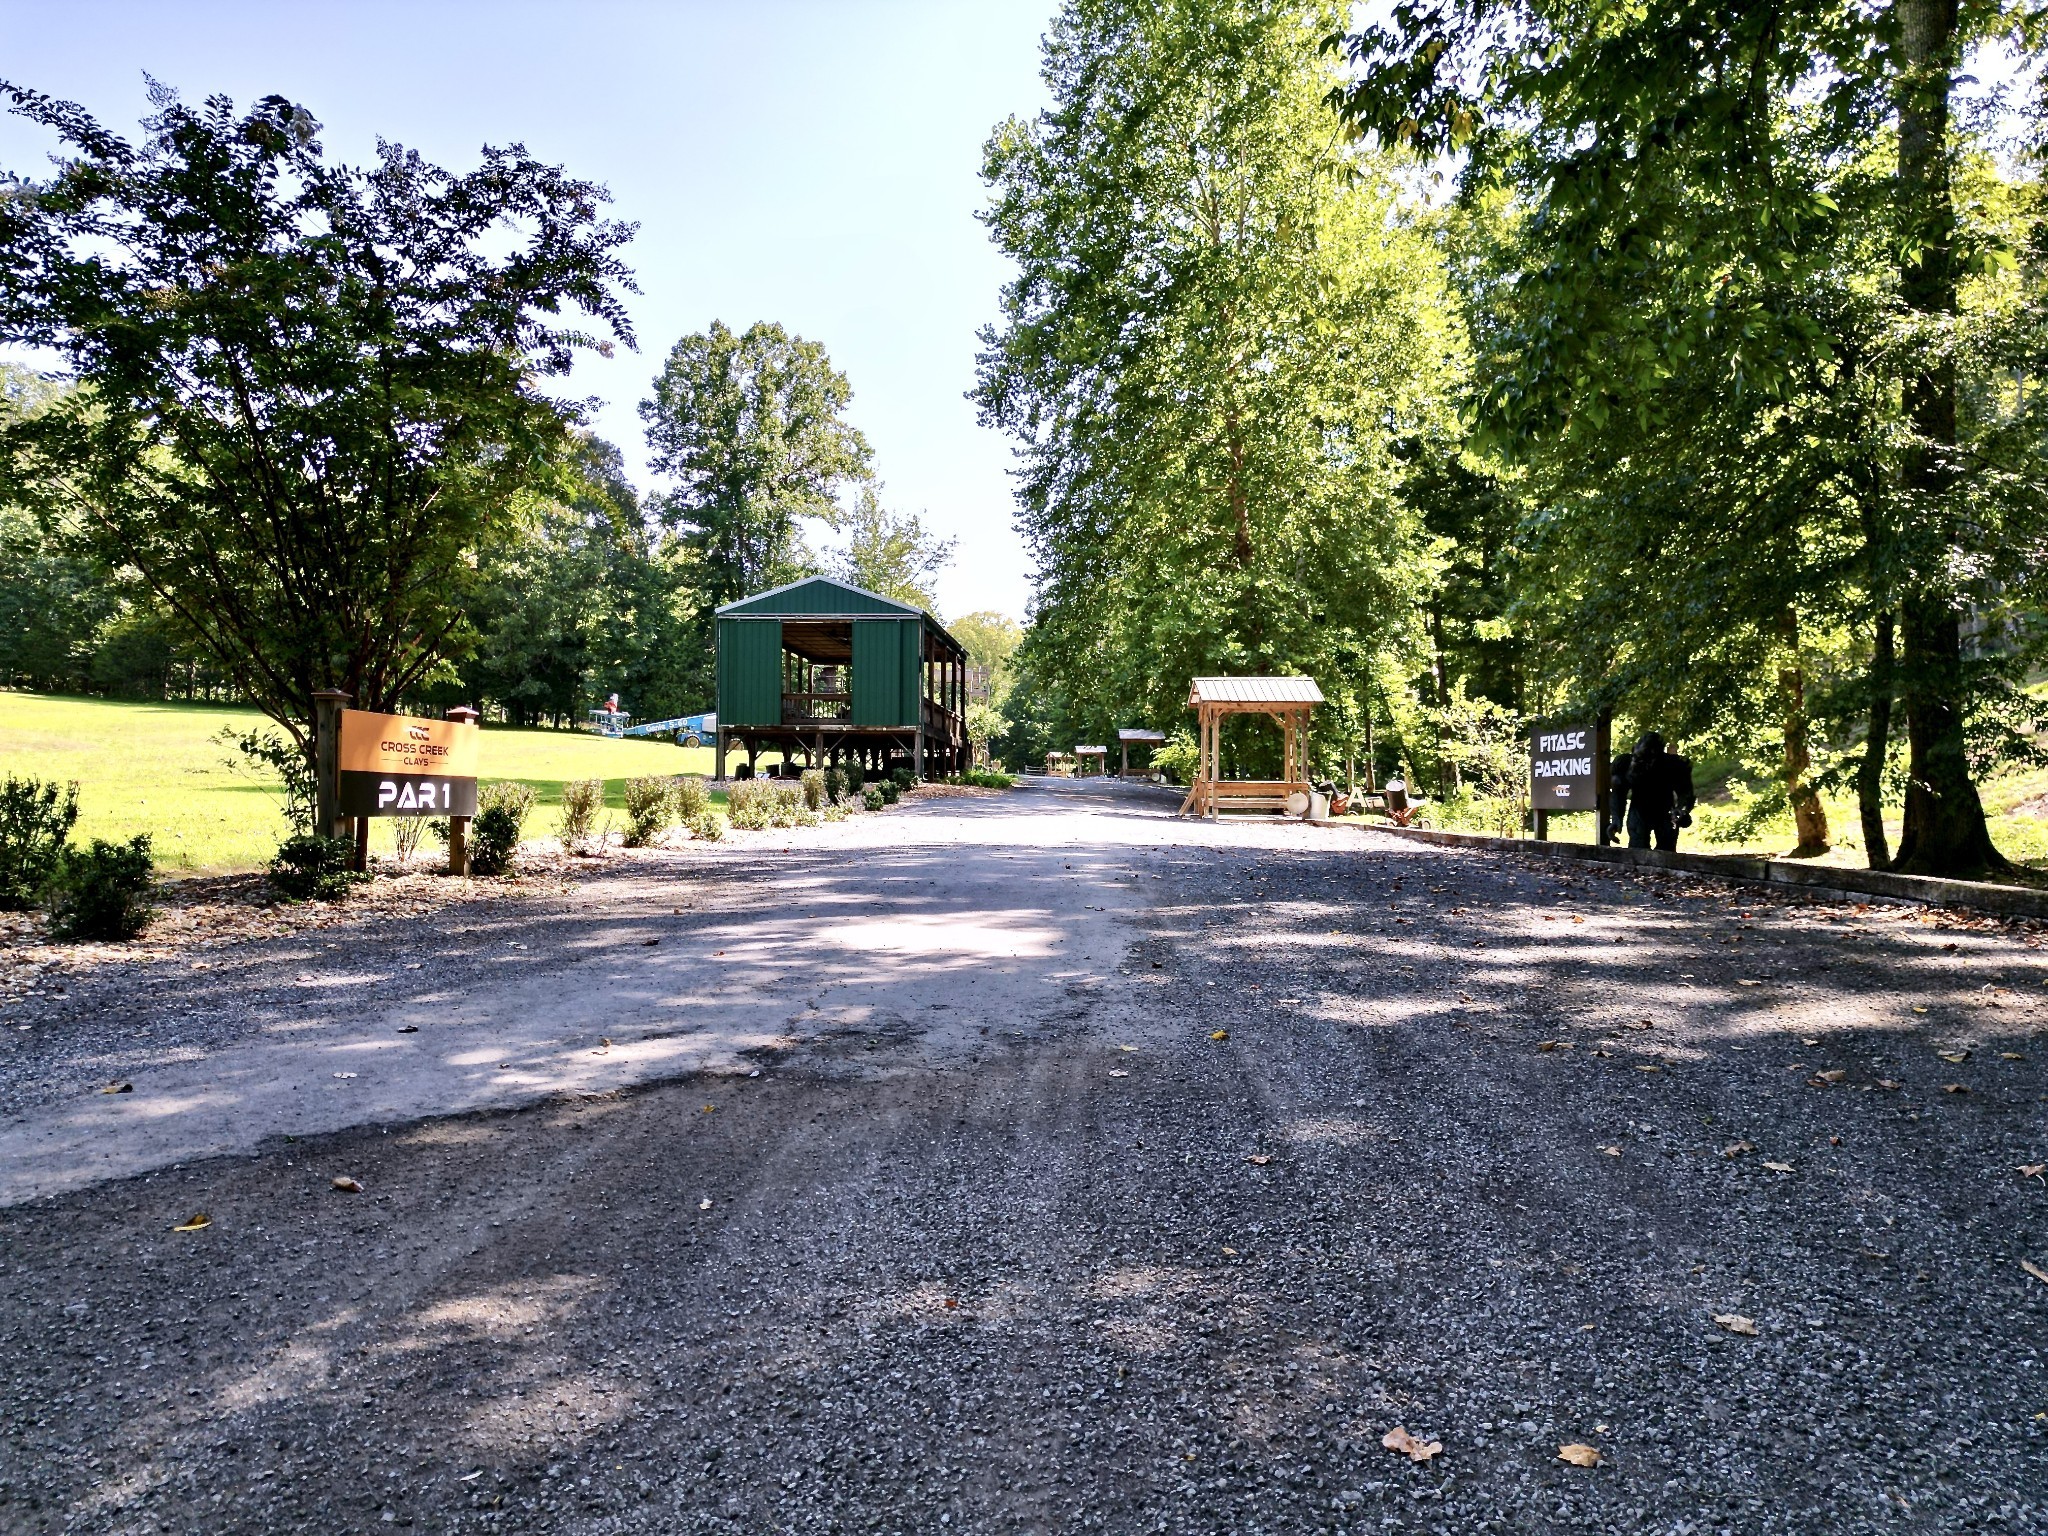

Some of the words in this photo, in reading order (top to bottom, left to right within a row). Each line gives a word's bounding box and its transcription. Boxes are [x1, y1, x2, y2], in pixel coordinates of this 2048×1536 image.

[645, 724, 666, 732] Genie
[669, 719, 688, 728] S-60
[381, 741, 417, 753] CROSS
[419, 744, 449, 756] CREEK
[1540, 731, 1586, 752] FITASC
[403, 756, 429, 766] CLAYS
[1534, 757, 1591, 778] PARKING
[378, 781, 436, 809] PAR
[442, 783, 450, 809] 1
